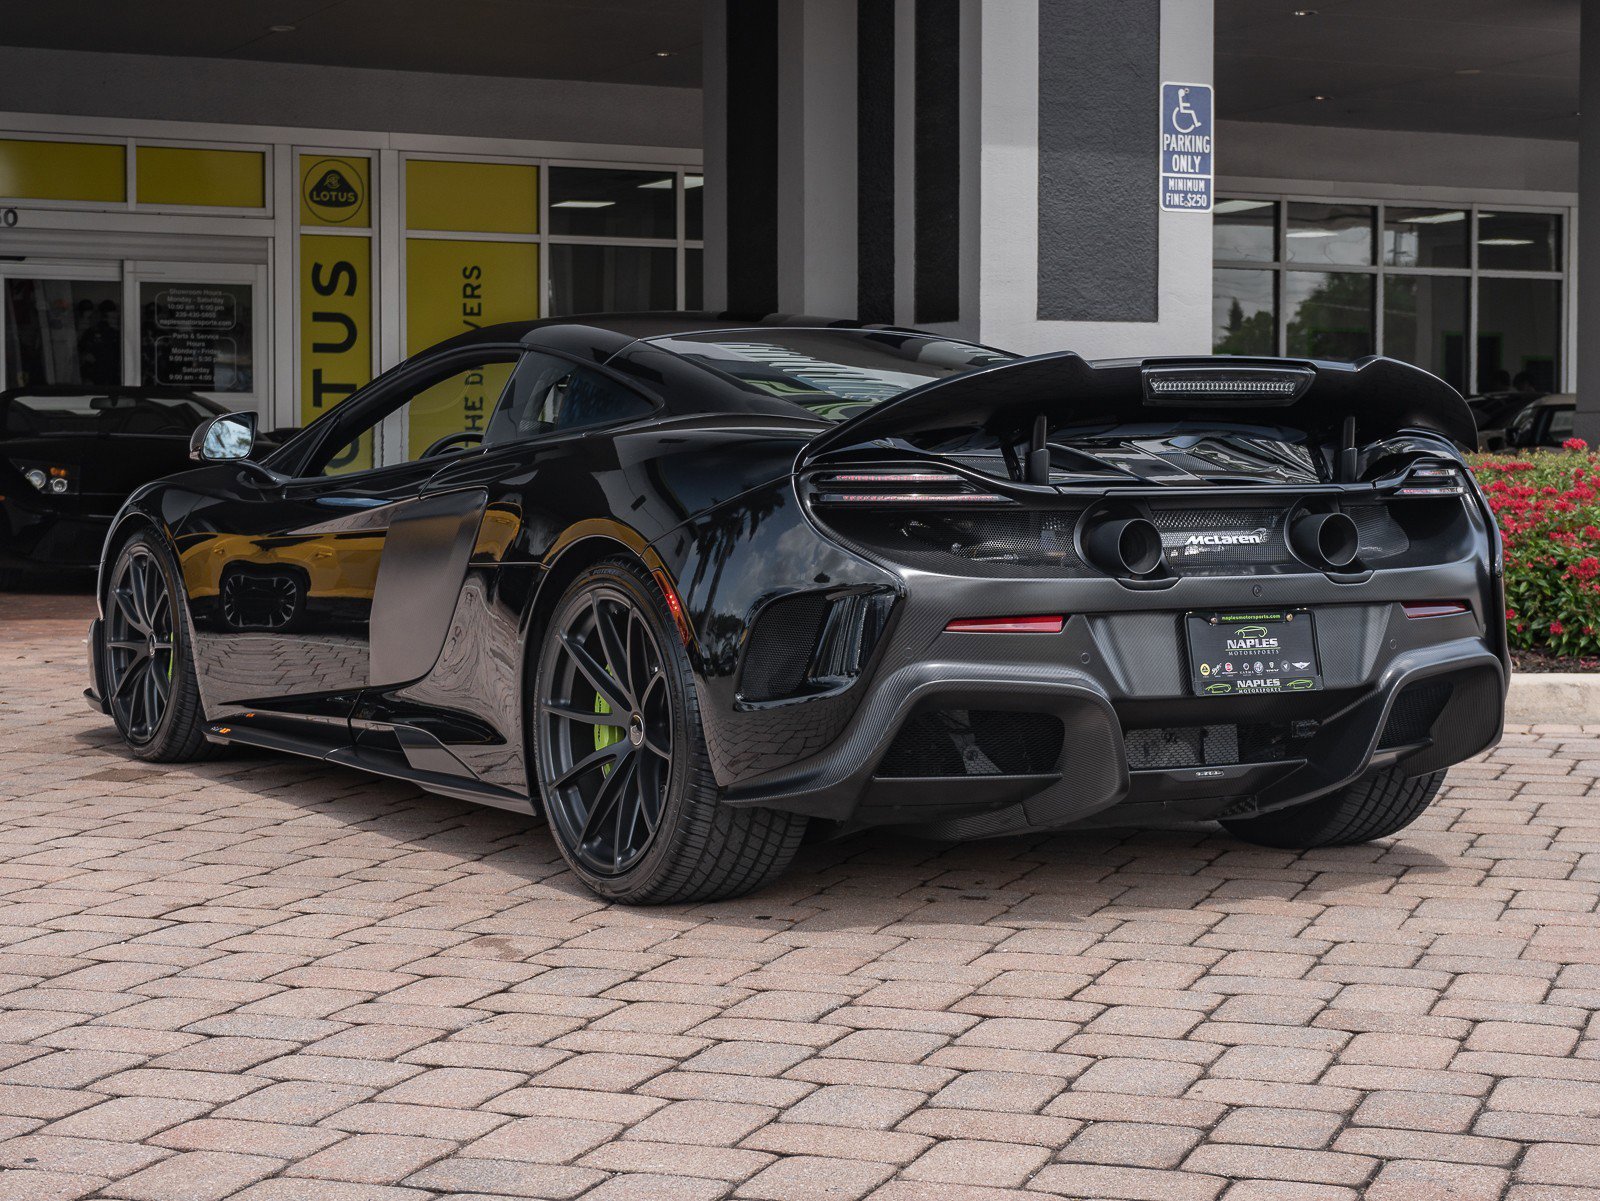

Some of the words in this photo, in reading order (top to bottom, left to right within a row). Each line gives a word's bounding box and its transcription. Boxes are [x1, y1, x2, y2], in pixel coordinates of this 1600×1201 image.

[1163, 134, 1211, 153] PARKING
[1171, 154, 1202, 173] ONLY
[1168, 178, 1206, 192] MINIMUM
[313, 191, 355, 202] LOTUS
[1165, 193, 1185, 206] FINE
[1187, 193, 1208, 208] $250
[0, 208, 18, 227] 0
[462, 265, 484, 386] DVERS
[1184, 535, 1261, 545] McLaren
[1221, 613, 1281, 622] naplesmotorsports.com
[1226, 638, 1279, 650] NAPLES
[1236, 678, 1281, 688] NAPLES
